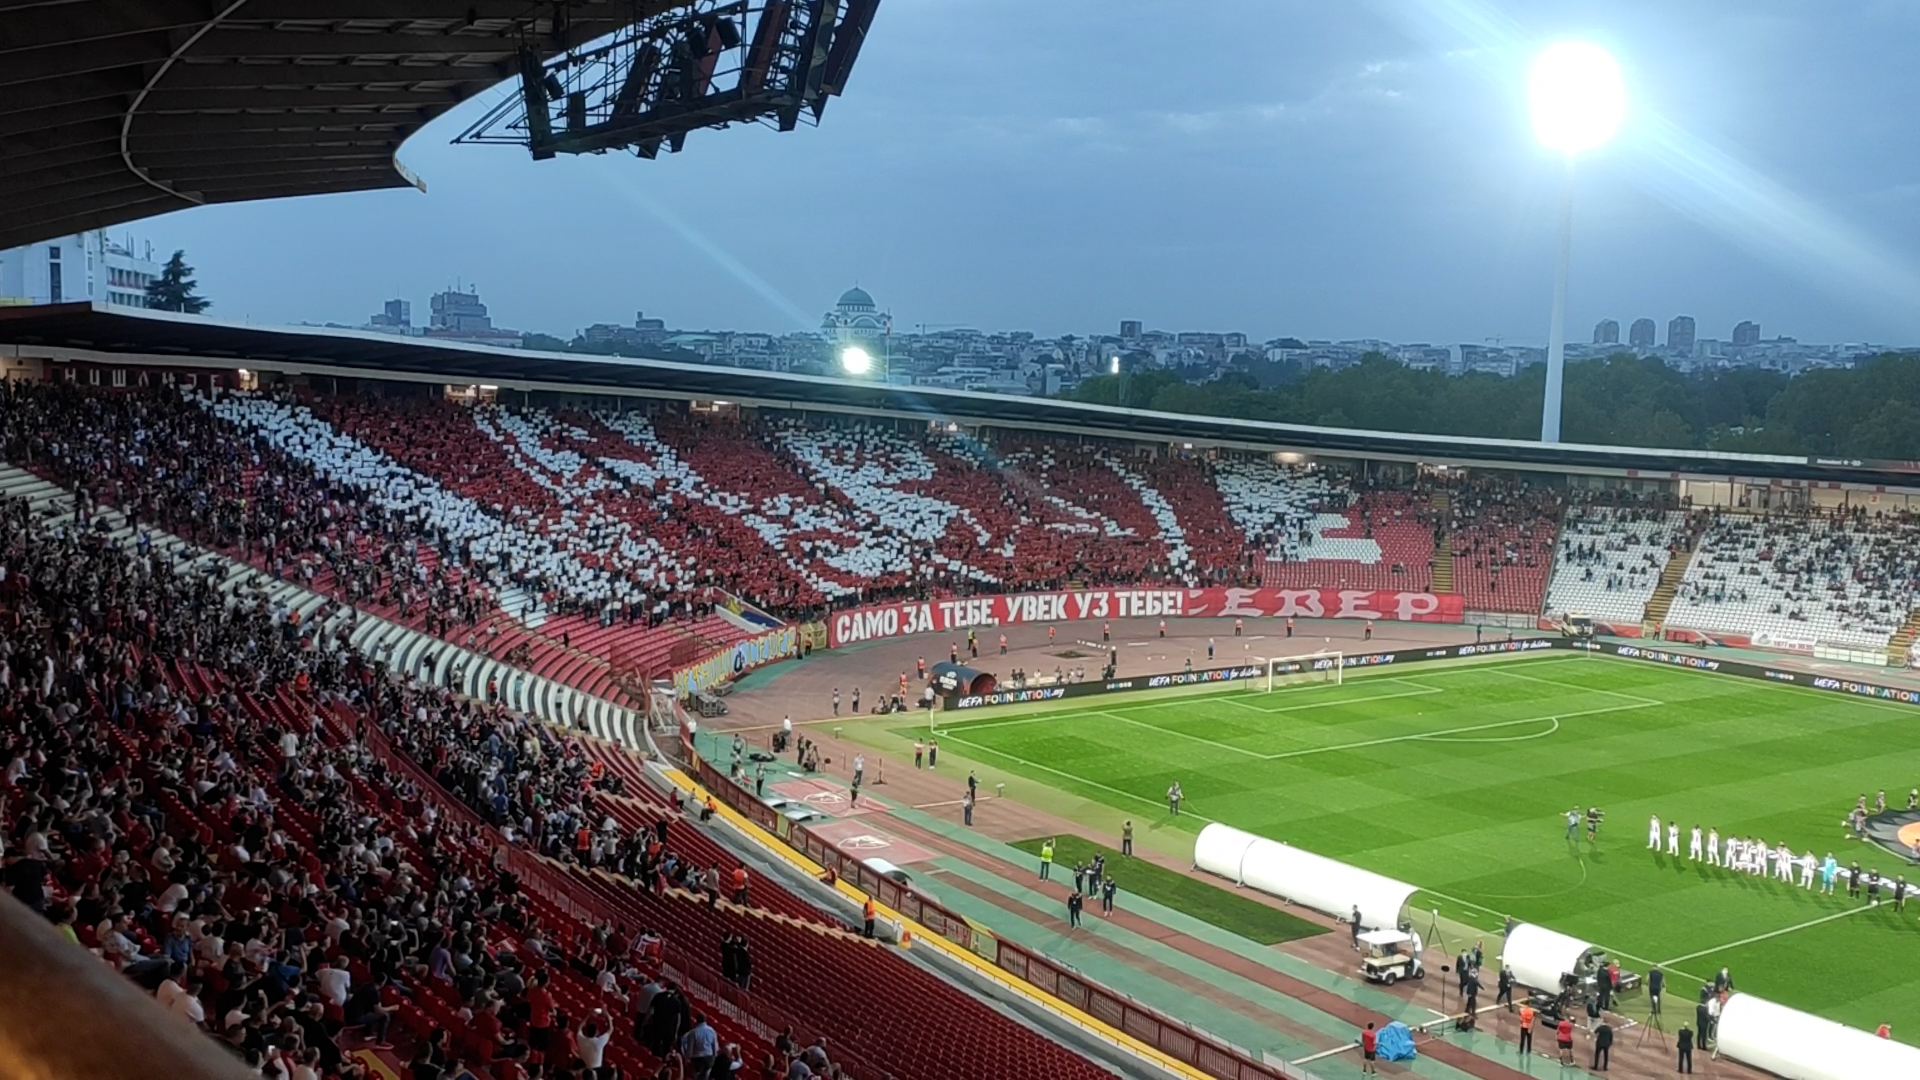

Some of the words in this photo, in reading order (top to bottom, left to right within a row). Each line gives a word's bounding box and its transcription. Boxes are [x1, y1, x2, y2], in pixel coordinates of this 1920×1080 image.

[836, 607, 898, 643] САМО
[902, 603, 934, 634] ЗА
[939, 599, 999, 629] ТЕБЕ,
[1005, 594, 1068, 622] УВЕК
[1075, 592, 1109, 618] УЗ
[1114, 590, 1183, 615] ТЕБЕ!
[1617, 646, 1640, 658] UEFA
[1149, 675, 1170, 687] UEFA
[1171, 669, 1230, 685] FOUNDATION
[1814, 677, 1840, 690] UEFA
[958, 694, 983, 708] UEFA
